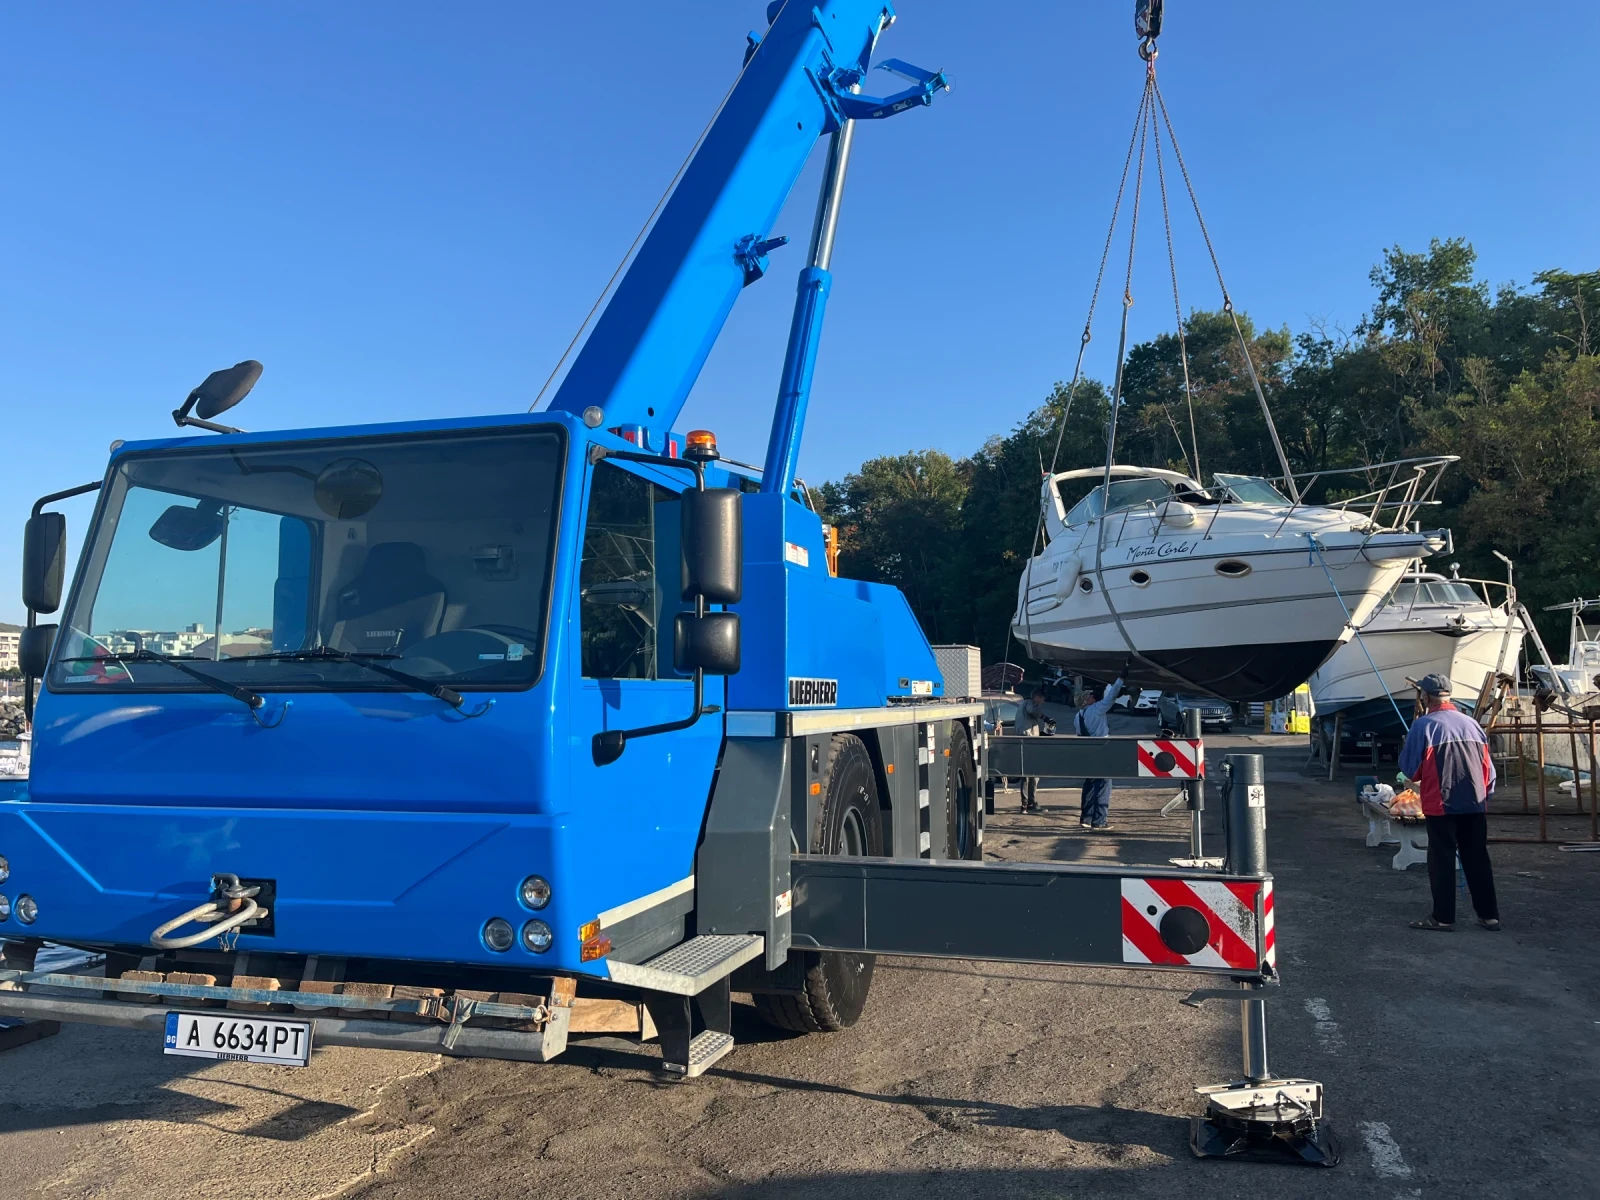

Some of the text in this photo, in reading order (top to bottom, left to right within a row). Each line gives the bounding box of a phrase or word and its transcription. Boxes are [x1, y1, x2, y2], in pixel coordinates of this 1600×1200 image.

[1127, 545, 1156, 562] Monte
[1157, 541, 1188, 557] Carlo
[789, 680, 837, 704] LIEBHERR
[166, 1035, 176, 1044] BG
[187, 1020, 200, 1046] A
[216, 1052, 249, 1061] LIEBHERR
